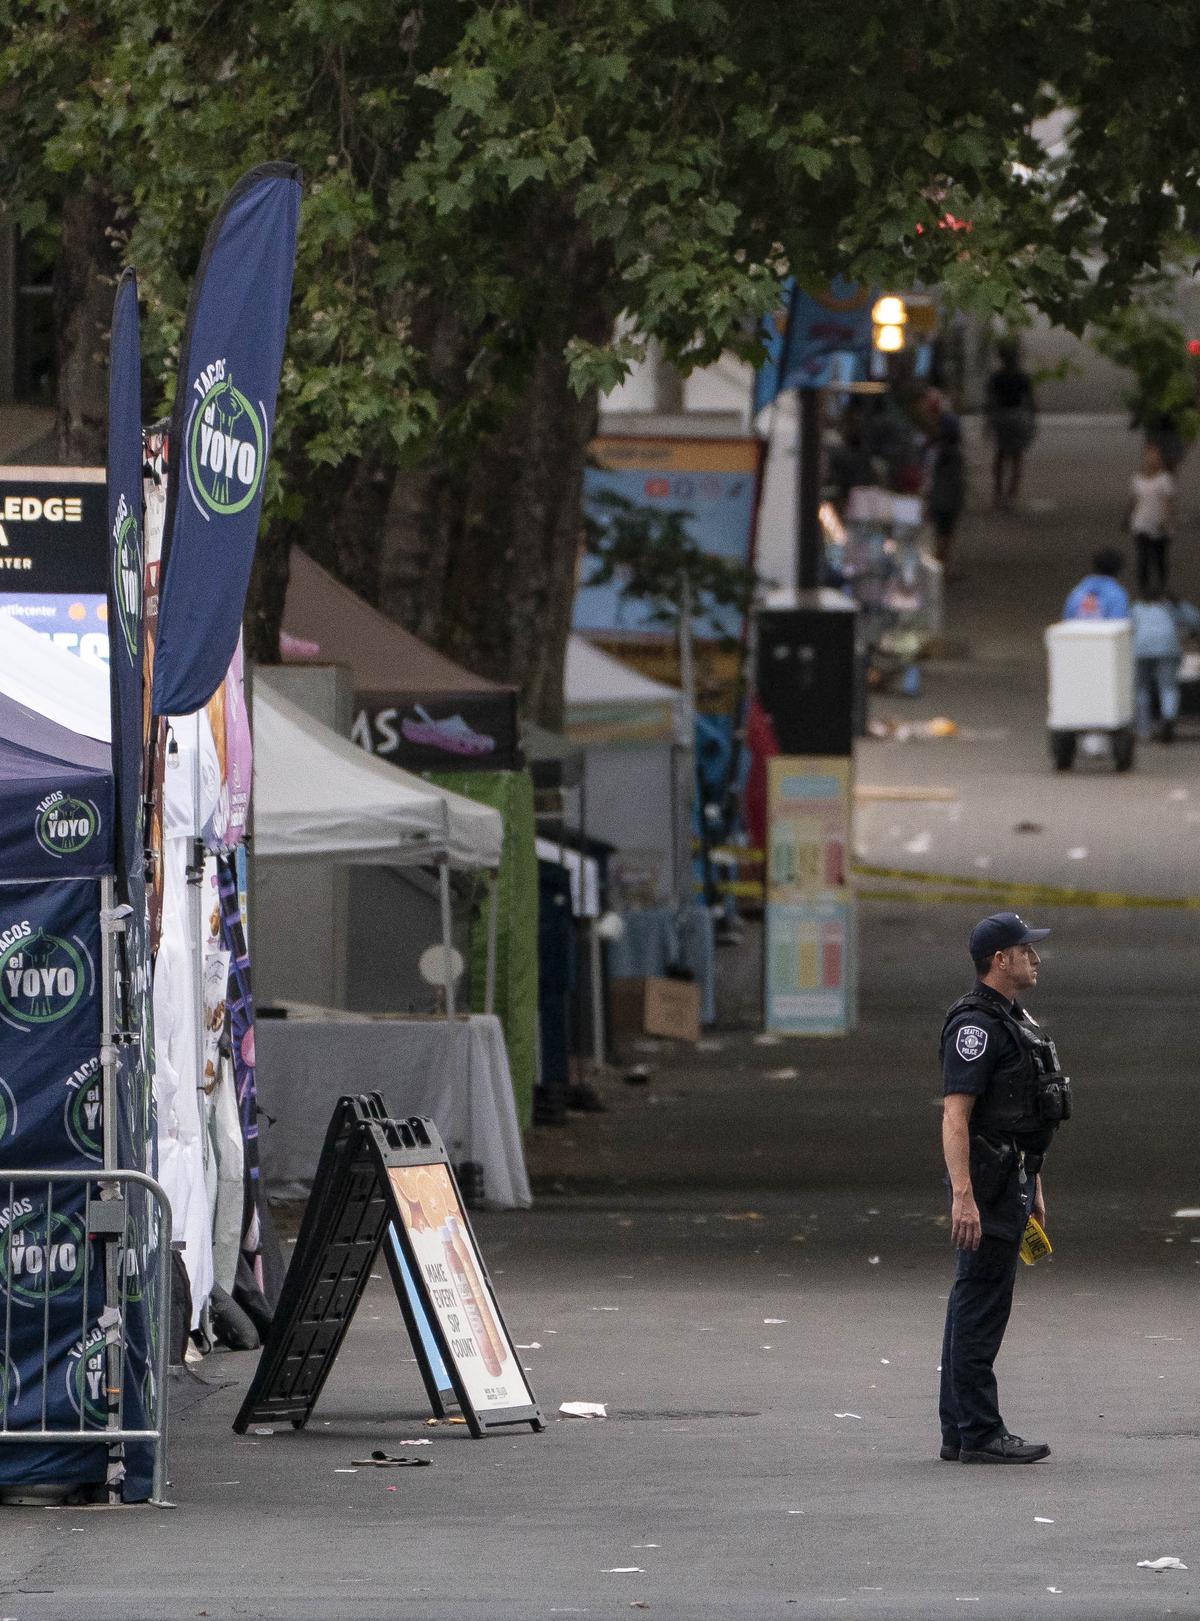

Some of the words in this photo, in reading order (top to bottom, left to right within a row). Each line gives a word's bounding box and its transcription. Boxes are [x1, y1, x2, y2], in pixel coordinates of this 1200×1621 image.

[194, 358, 226, 399] TACOS
[204, 402, 216, 424] el
[201, 423, 256, 485] YOYO
[36, 790, 63, 812] TACOS
[48, 811, 59, 820] el
[47, 818, 90, 838] YOYO
[0, 920, 31, 956] ACOS
[9, 953, 23, 968] el
[6, 967, 75, 997] YOYO
[963, 1029, 983, 1039] SEATTLE
[961, 1047, 978, 1056] POLICE
[66, 1057, 99, 1090] TACO
[87, 1085, 99, 1101] el
[0, 1197, 32, 1234] ACOS
[12, 1230, 24, 1246] el
[11, 1243, 76, 1275] YOYO
[425, 1263, 448, 1283] MAKE
[434, 1288, 457, 1308] EVERY
[447, 1314, 460, 1333] SIP
[67, 1328, 104, 1359] TACO
[451, 1338, 477, 1359] COUNT
[88, 1354, 101, 1370] el
